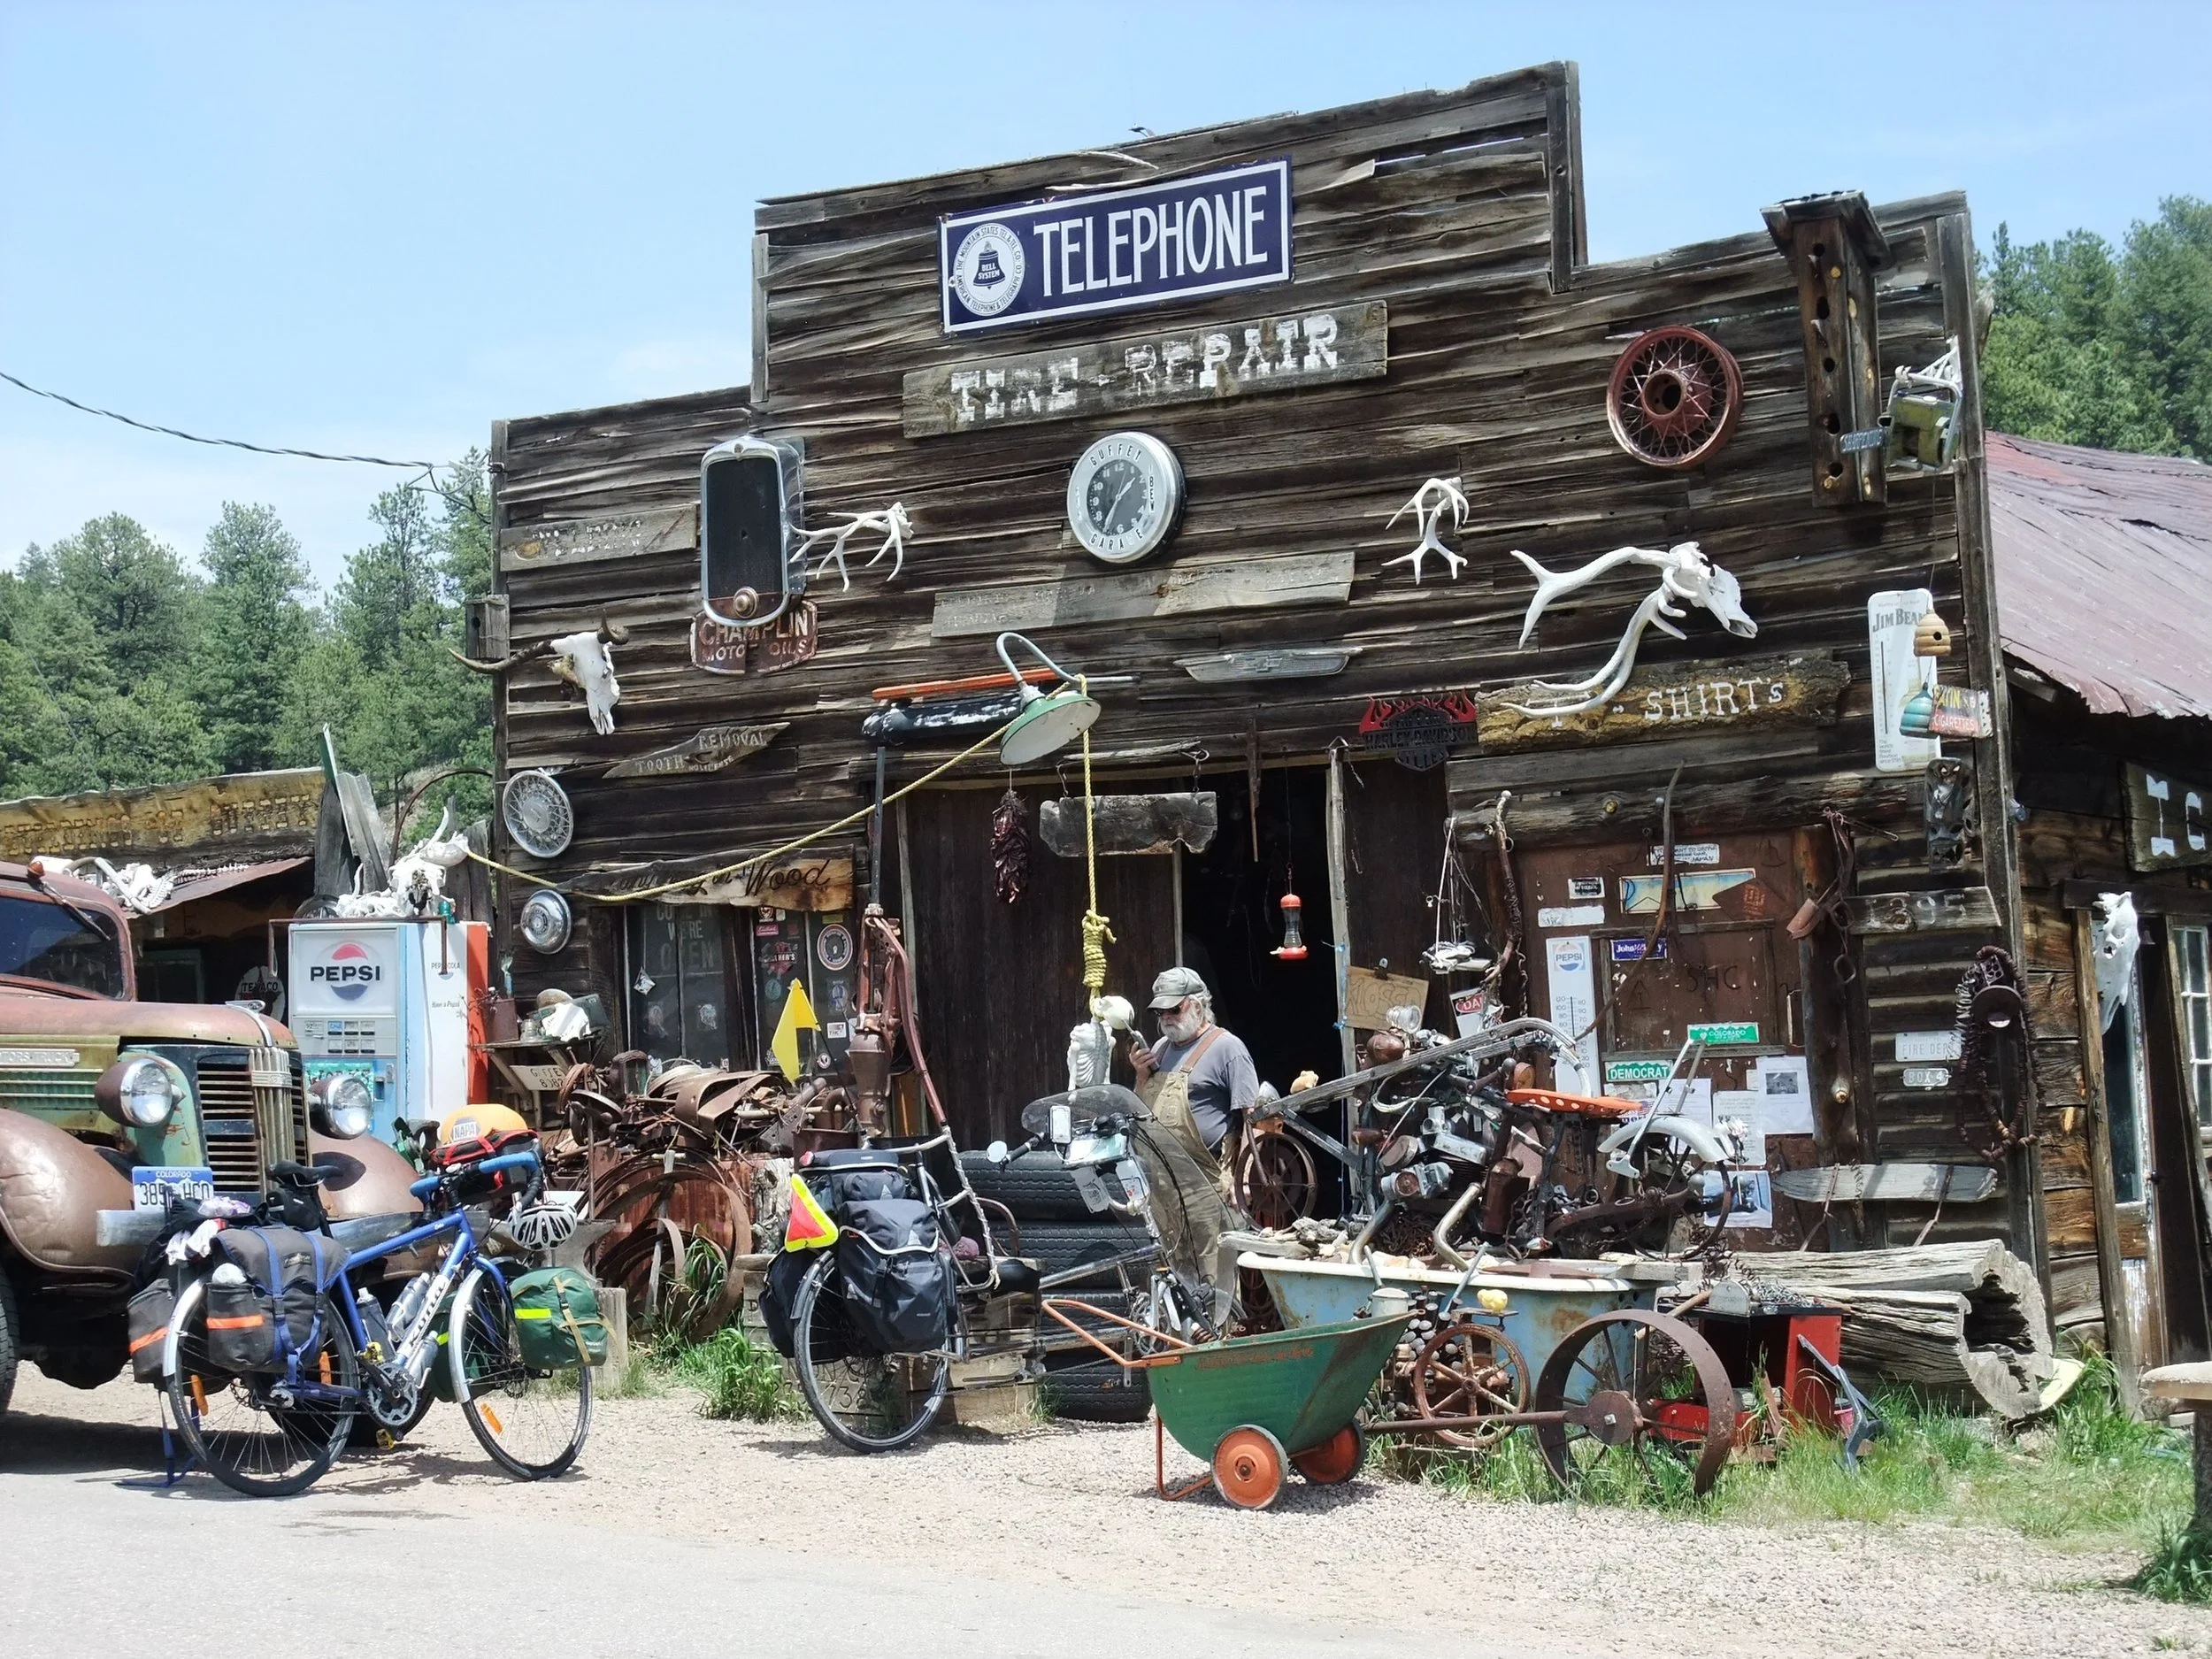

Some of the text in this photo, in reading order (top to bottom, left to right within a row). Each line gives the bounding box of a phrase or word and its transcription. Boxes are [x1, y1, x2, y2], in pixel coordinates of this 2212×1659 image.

[959, 233, 980, 257] MOUNTAIN
[980, 226, 999, 237] STATES
[1033, 186, 1268, 297] TELEPHONE
[978, 270, 1001, 280] SYSTEM
[981, 263, 997, 272] BELL
[956, 274, 971, 303] AMERICAN
[970, 300, 997, 312] TELEPHONE
[999, 276, 1020, 306] TELEGRAPH
[1125, 314, 1338, 396] REPAIR
[1089, 443, 1141, 465] GUFFEY
[1114, 461, 1125, 472] 12
[1093, 480, 1103, 491] 10
[1092, 496, 1099, 506] 9
[1095, 511, 1102, 521] 8
[1116, 523, 1124, 534] 6
[698, 608, 809, 645] CHAMPLIN
[1872, 612, 1894, 633] JIM
[703, 638, 807, 662] MOTO OILS
[1934, 714, 1975, 732] CIGARETTES
[635, 731, 767, 772] TOOTH REMOVAL
[743, 858, 831, 896] Wood
[661, 941, 715, 972] OEN
[310, 965, 380, 981] PEPSI
[241, 980, 279, 992] TEXACO
[1902, 1043, 1925, 1056] FIRE
[1609, 1066, 1669, 1079] DEMOCRAT
[1908, 1071, 1931, 1083] BOX
[453, 1123, 476, 1139] NAPA
[140, 1182, 166, 1206] 385
